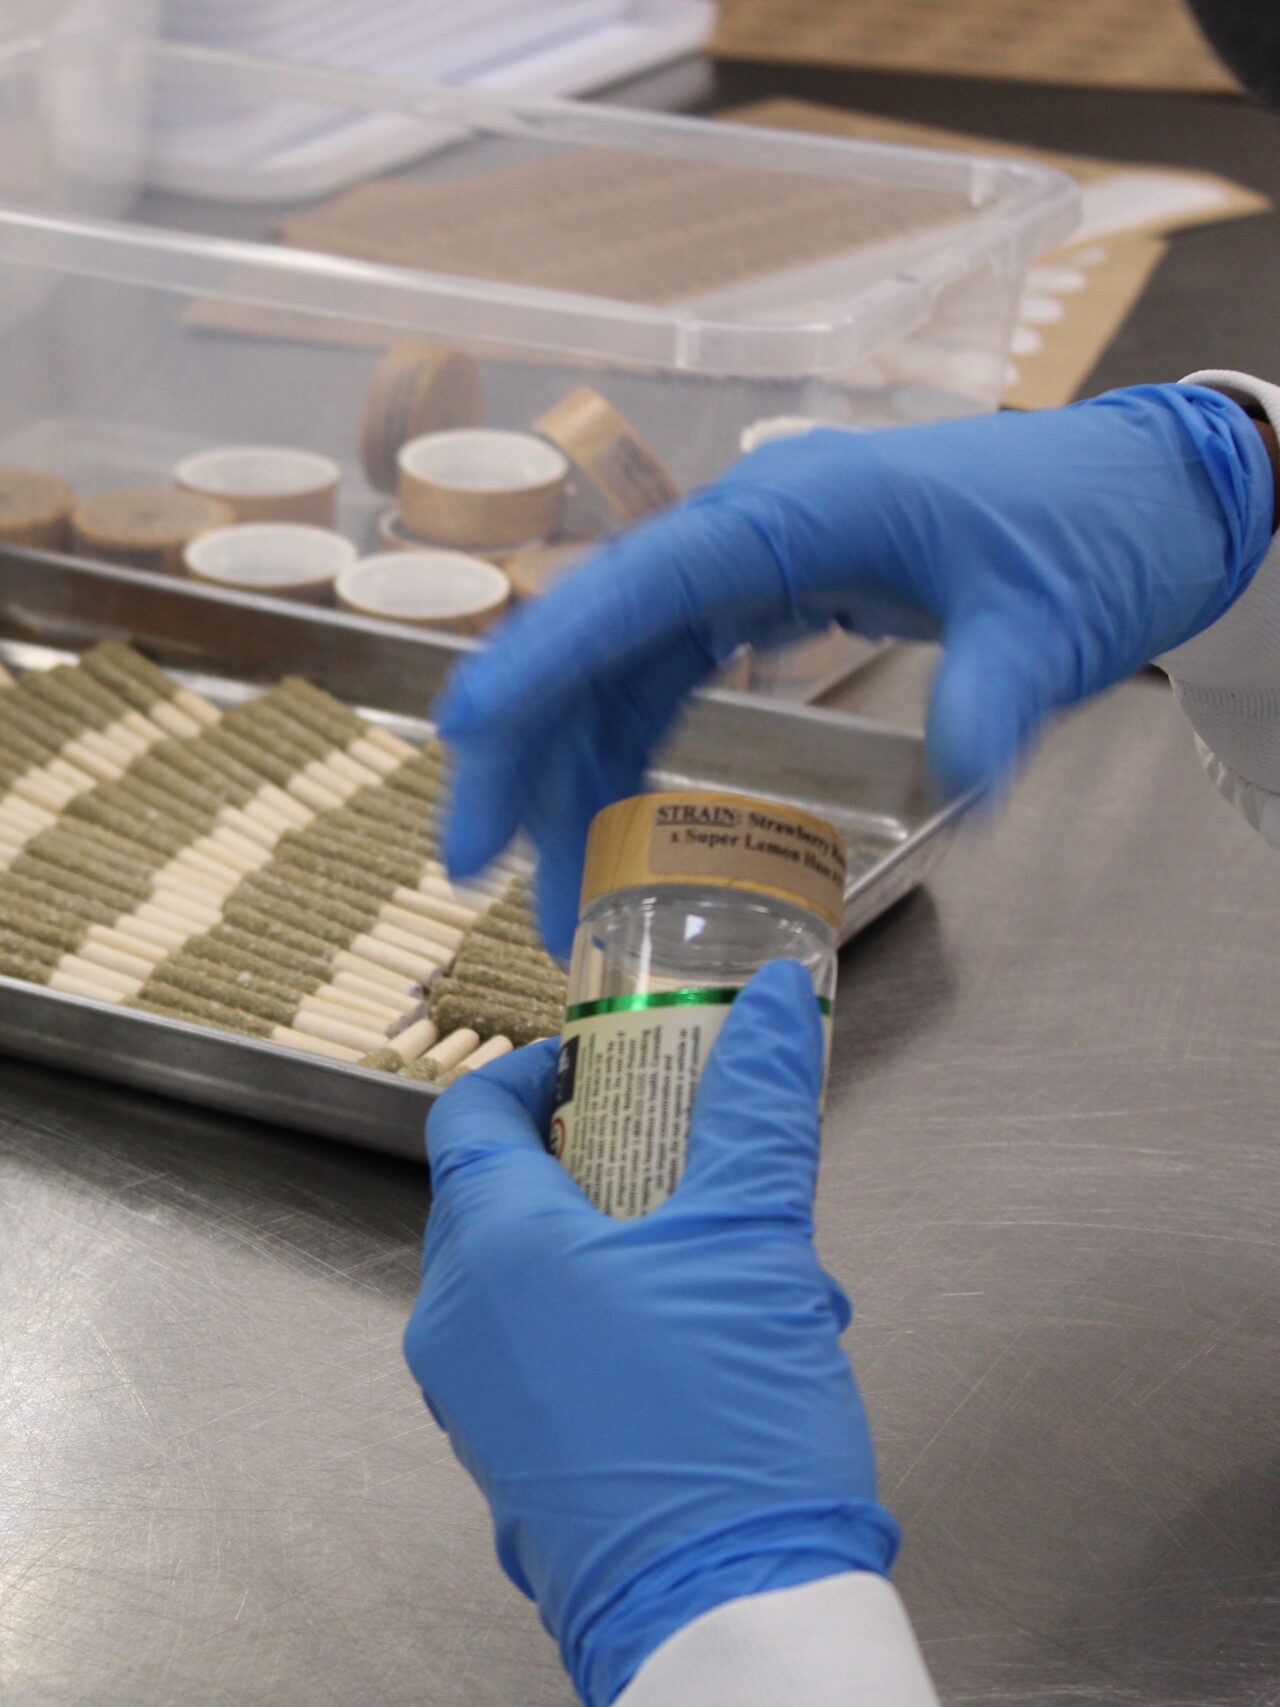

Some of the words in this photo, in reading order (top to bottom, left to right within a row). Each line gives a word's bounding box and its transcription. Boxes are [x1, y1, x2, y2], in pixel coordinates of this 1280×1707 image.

[656, 805, 741, 828] STRAIN:
[748, 812, 829, 857] Strawberry
[685, 829, 740, 849] Super
[744, 832, 800, 863] Lemon
